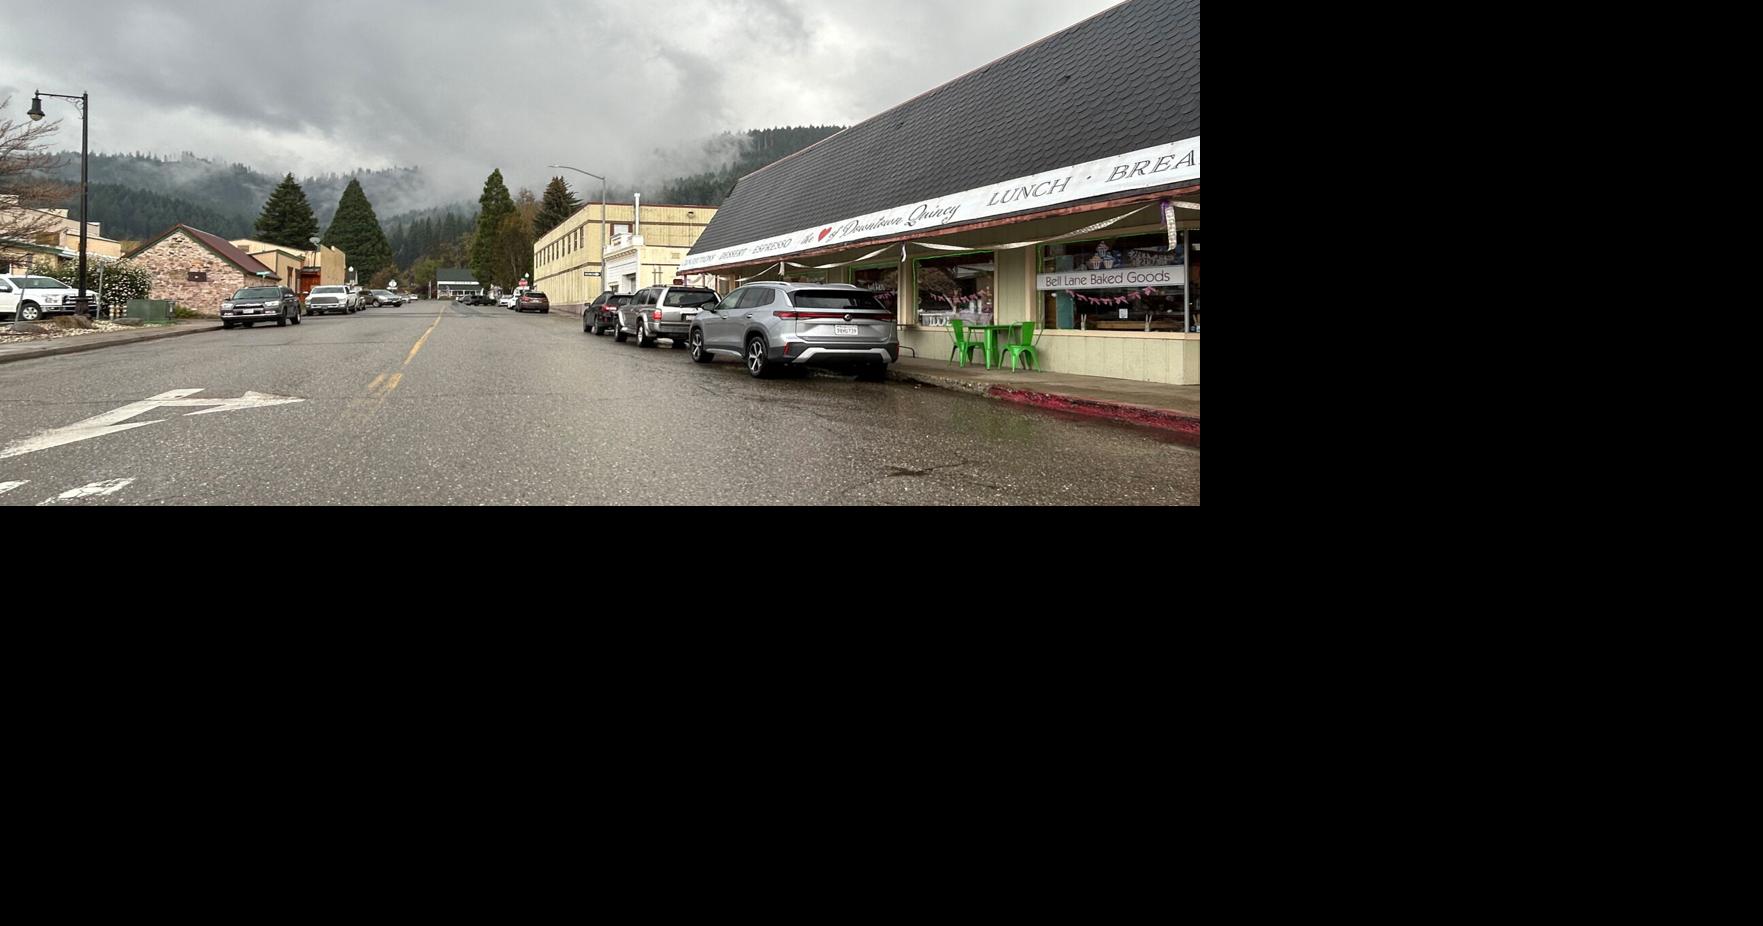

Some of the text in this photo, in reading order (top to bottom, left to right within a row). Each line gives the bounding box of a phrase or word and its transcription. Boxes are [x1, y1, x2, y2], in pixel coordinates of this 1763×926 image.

[752, 238, 793, 254] ESPRESSO
[825, 225, 843, 243] of
[839, 216, 904, 239] Downtown
[904, 204, 961, 227] Quincy
[986, 176, 1072, 206] LUNCH
[1105, 149, 1200, 183] BREA
[1045, 269, 1170, 287] Bell Lane Baked Goods
